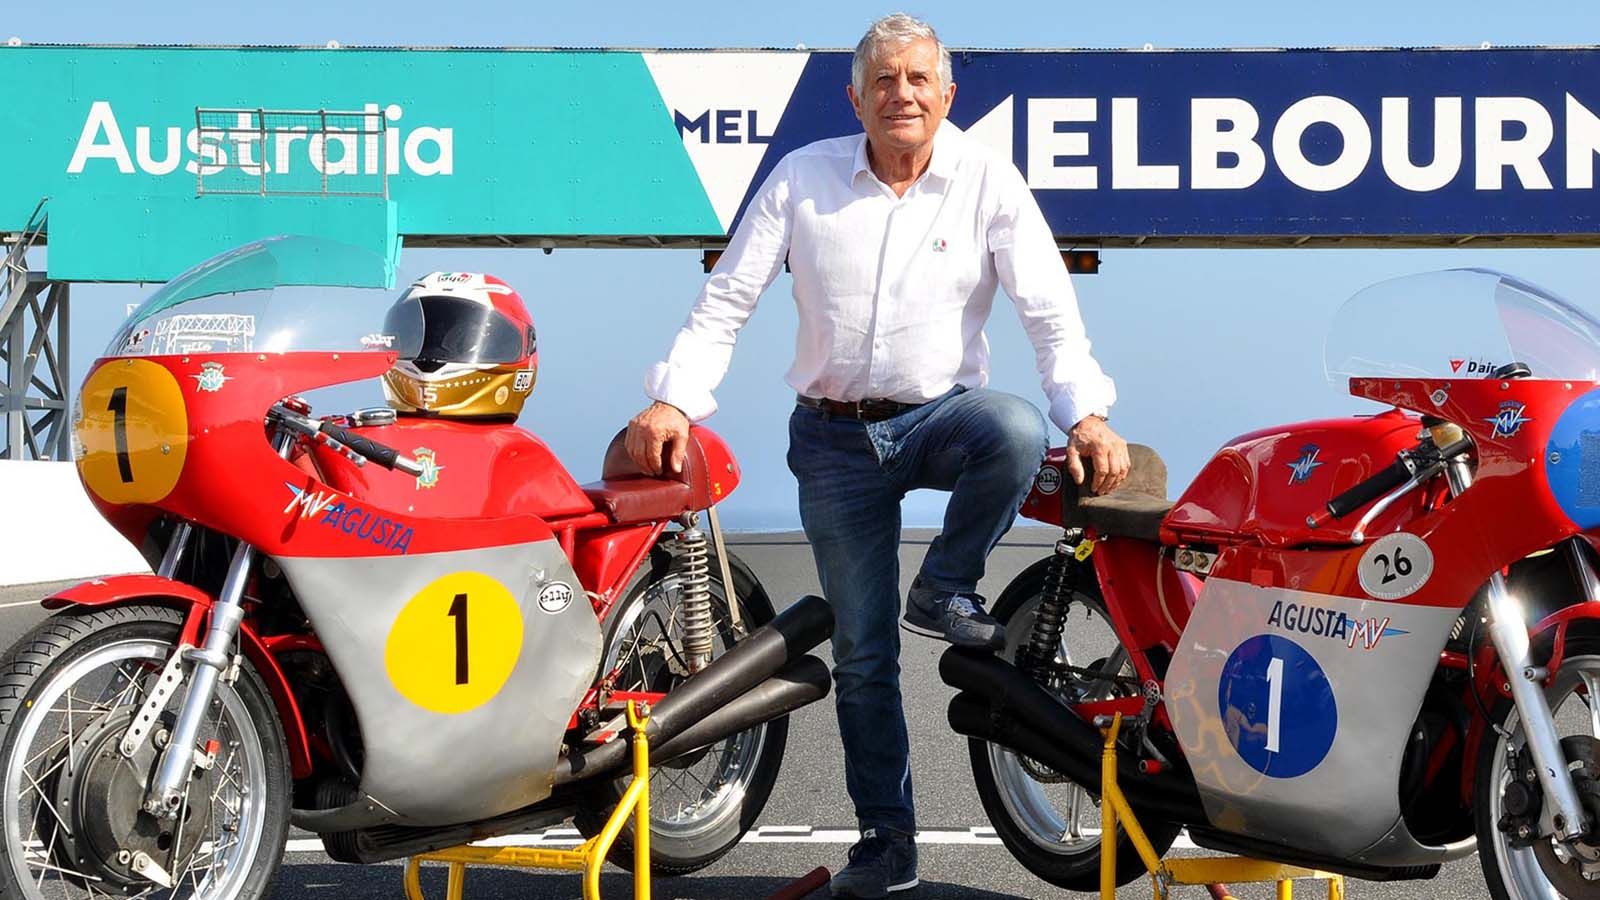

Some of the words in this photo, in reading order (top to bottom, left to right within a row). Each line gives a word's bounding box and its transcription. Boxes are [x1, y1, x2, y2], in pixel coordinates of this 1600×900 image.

[67, 101, 453, 177] Australia
[675, 108, 773, 144] MEL
[107, 387, 134, 484] 1
[284, 486, 337, 520] MV
[322, 503, 415, 554] AGUSTA
[538, 588, 571, 608] elly
[1373, 546, 1413, 585] 26
[448, 593, 469, 686] 1
[1267, 599, 1348, 638] AGUSTA
[1346, 616, 1390, 649] MV
[1264, 656, 1285, 754] 1
